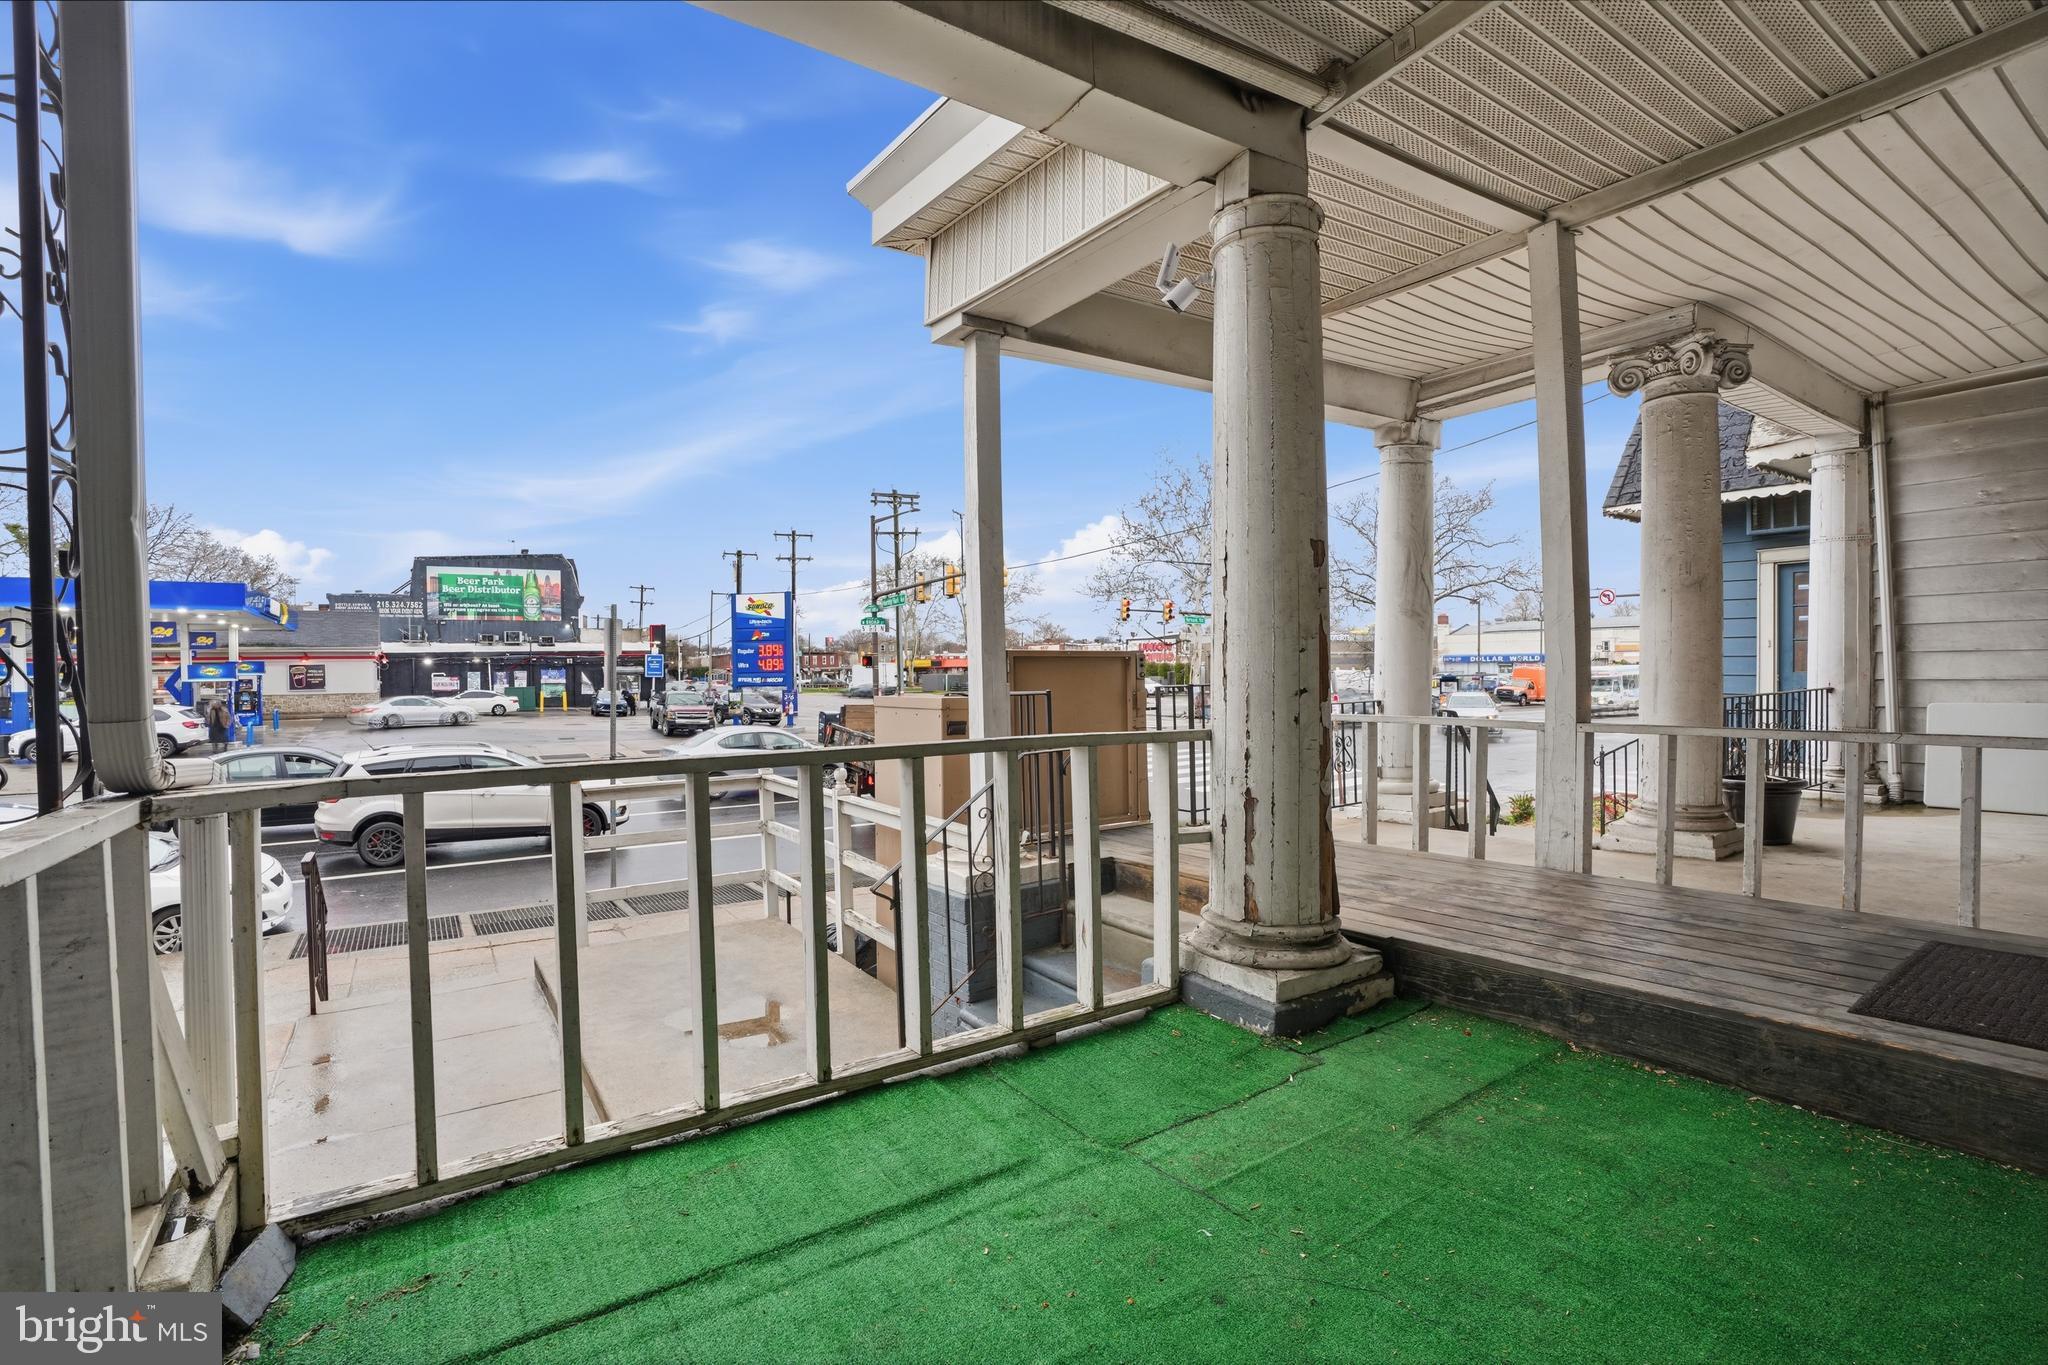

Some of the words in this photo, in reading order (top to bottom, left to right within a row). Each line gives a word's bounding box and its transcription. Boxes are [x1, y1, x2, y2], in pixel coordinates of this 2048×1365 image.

[457, 577, 480, 585] Beer
[482, 577, 504, 586] Park
[442, 585, 466, 593] Beer
[468, 585, 521, 594] Distributor
